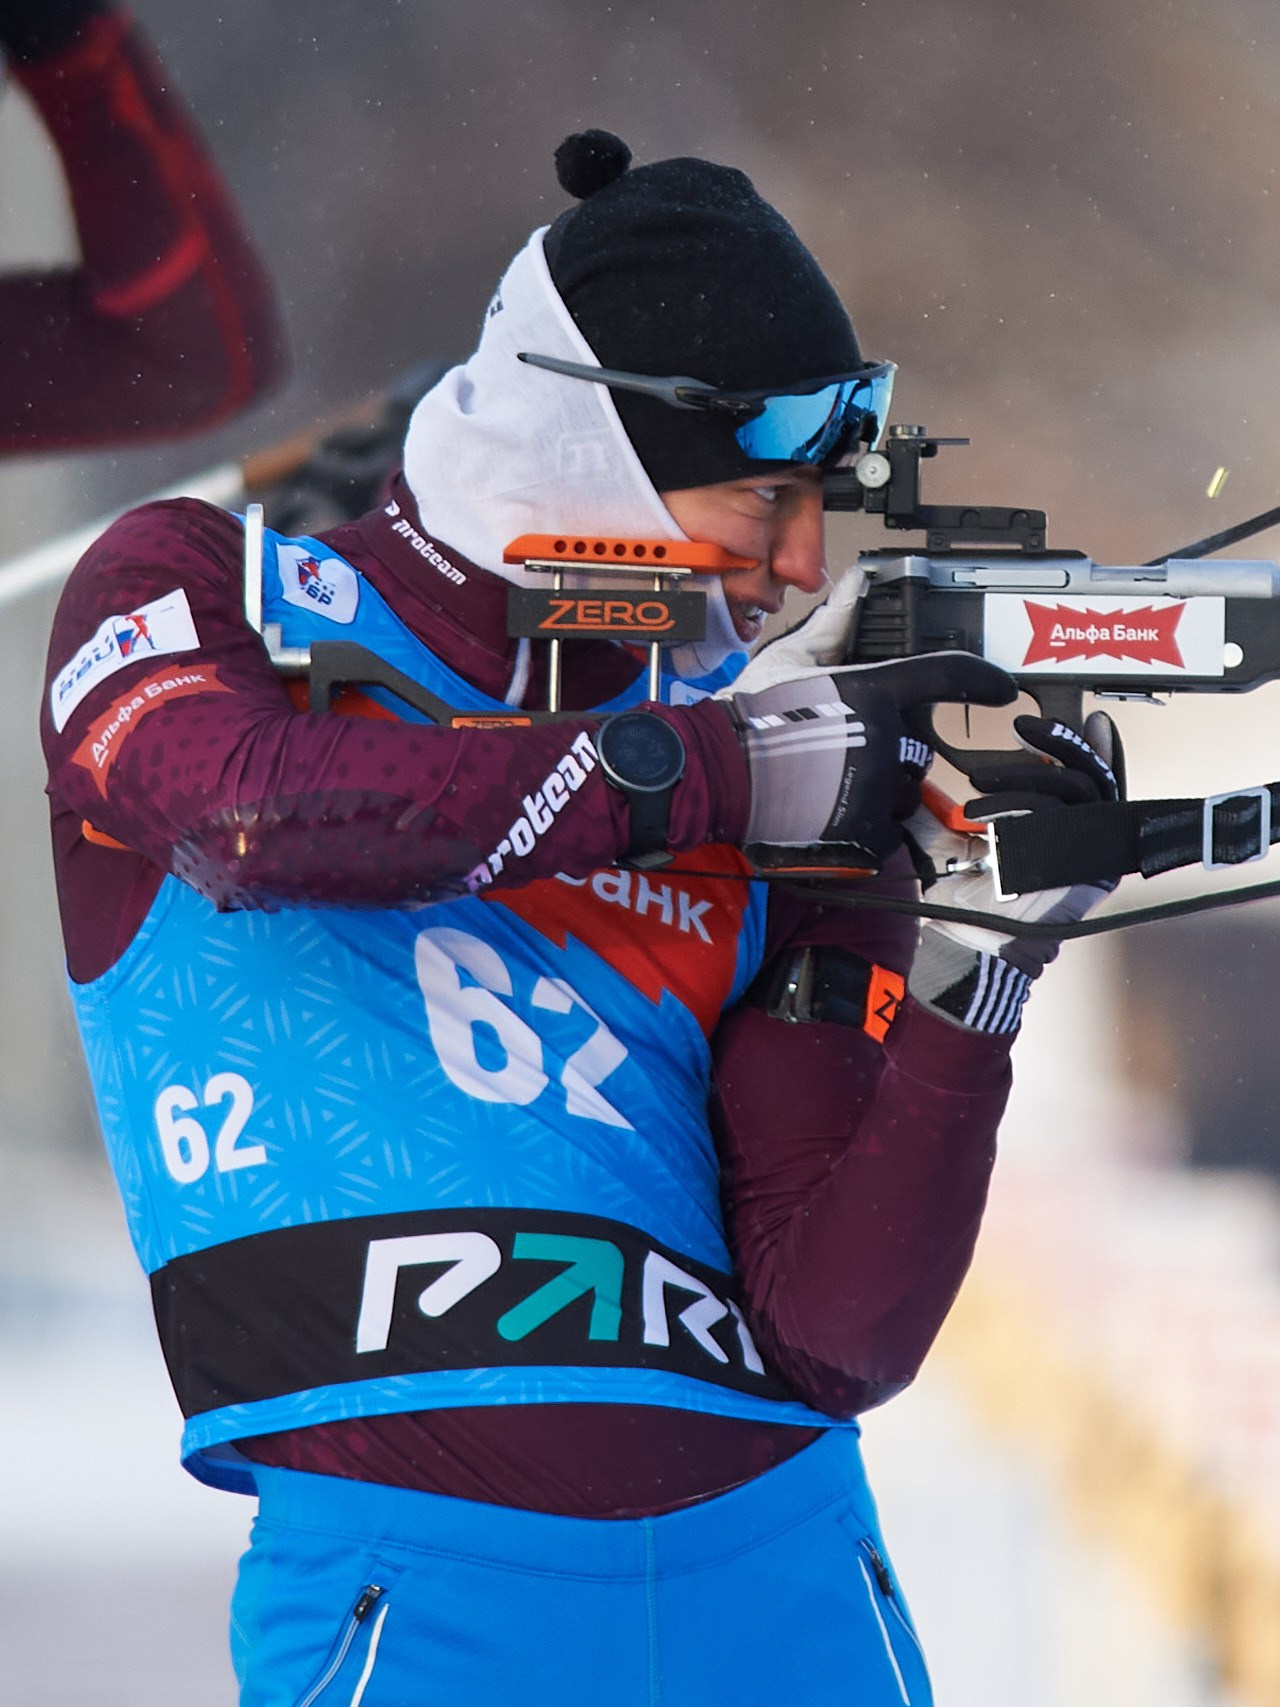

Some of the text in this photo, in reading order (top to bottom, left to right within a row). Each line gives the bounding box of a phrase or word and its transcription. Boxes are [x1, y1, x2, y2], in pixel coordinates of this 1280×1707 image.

[537, 599, 676, 631] ZERO
[1049, 623, 1159, 647] Альфа Банк
[90, 673, 208, 769] Альфа Банк
[554, 869, 715, 946] анк
[413, 926, 634, 1132] 62
[154, 1072, 268, 1184] 62
